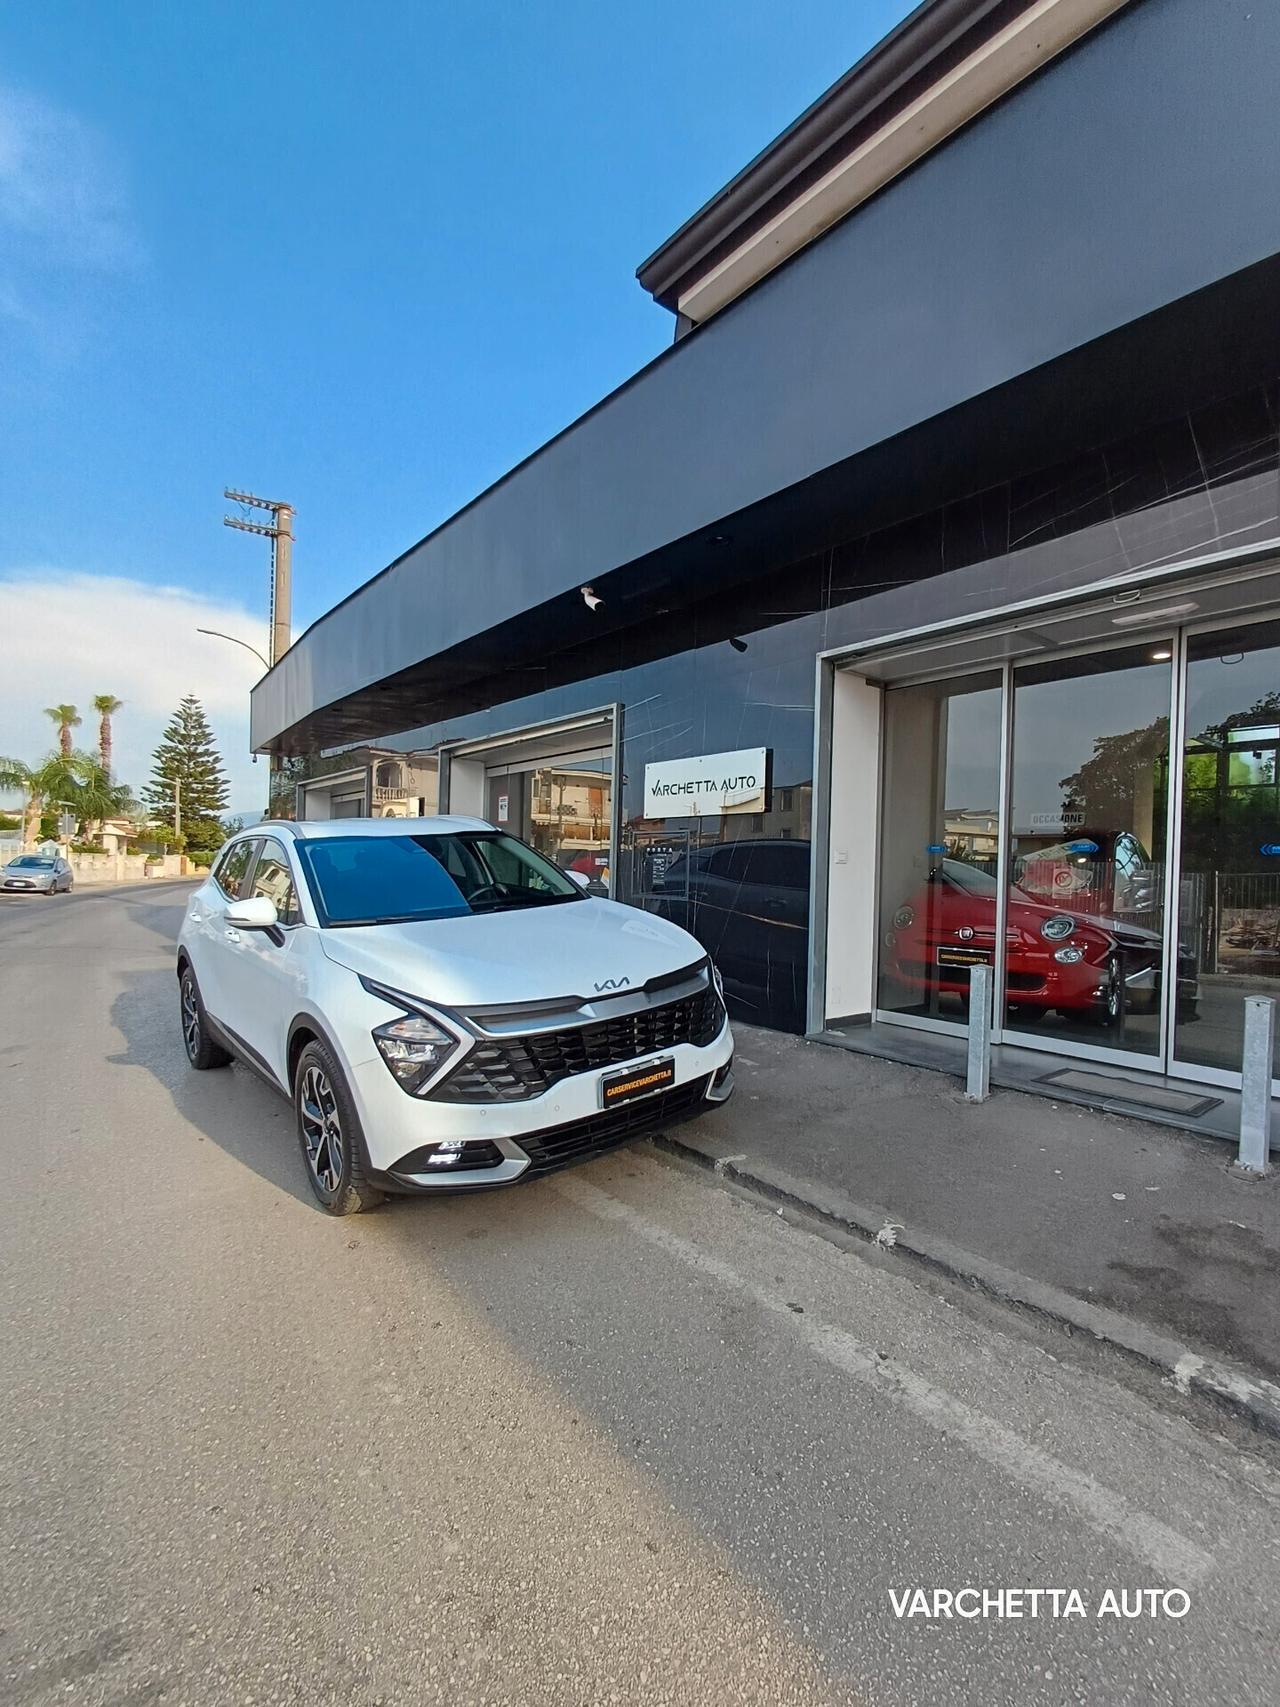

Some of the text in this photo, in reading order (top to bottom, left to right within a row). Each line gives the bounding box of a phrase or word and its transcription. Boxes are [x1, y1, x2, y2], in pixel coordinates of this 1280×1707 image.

[651, 776, 756, 796] VARCHETTA AUTO
[1033, 814, 1083, 825] OCCASIONE
